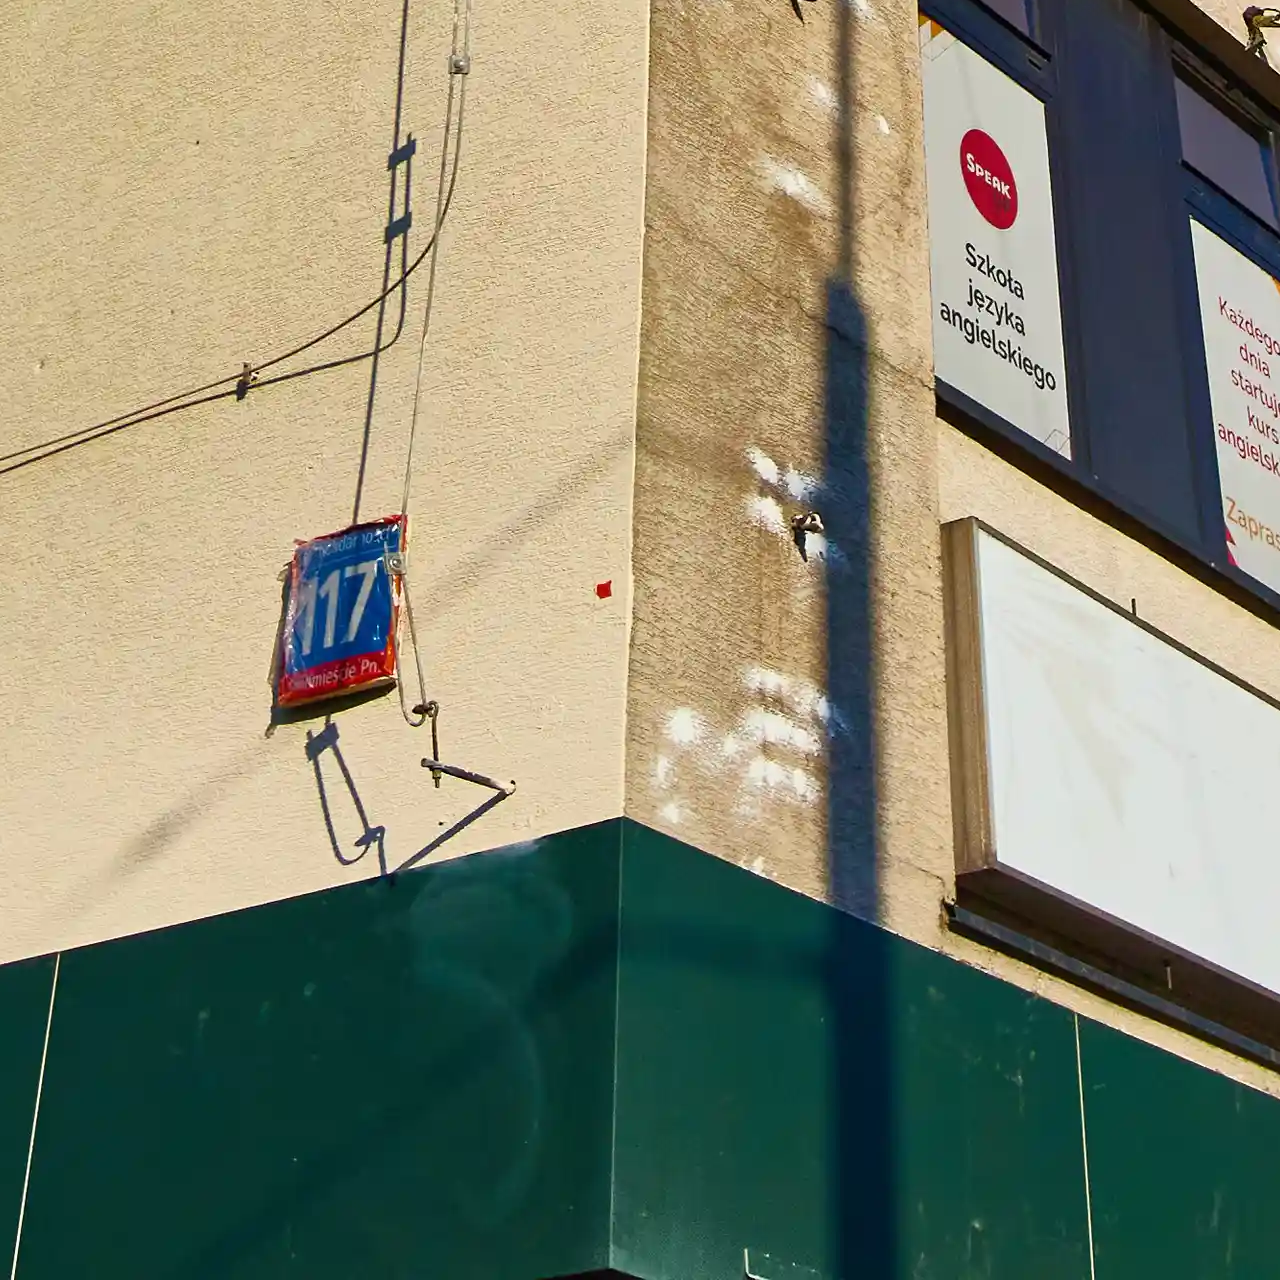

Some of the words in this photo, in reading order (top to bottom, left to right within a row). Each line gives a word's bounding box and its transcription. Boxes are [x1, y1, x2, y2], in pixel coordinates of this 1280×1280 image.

[966, 153, 1011, 200] SPEAK
[965, 242, 1024, 300] Szkoła
[967, 278, 1025, 336] języka
[1218, 296, 1280, 356] Każdego
[940, 302, 1056, 390] angielskiego
[1239, 344, 1270, 378] dnia
[1247, 405, 1279, 444] kurs
